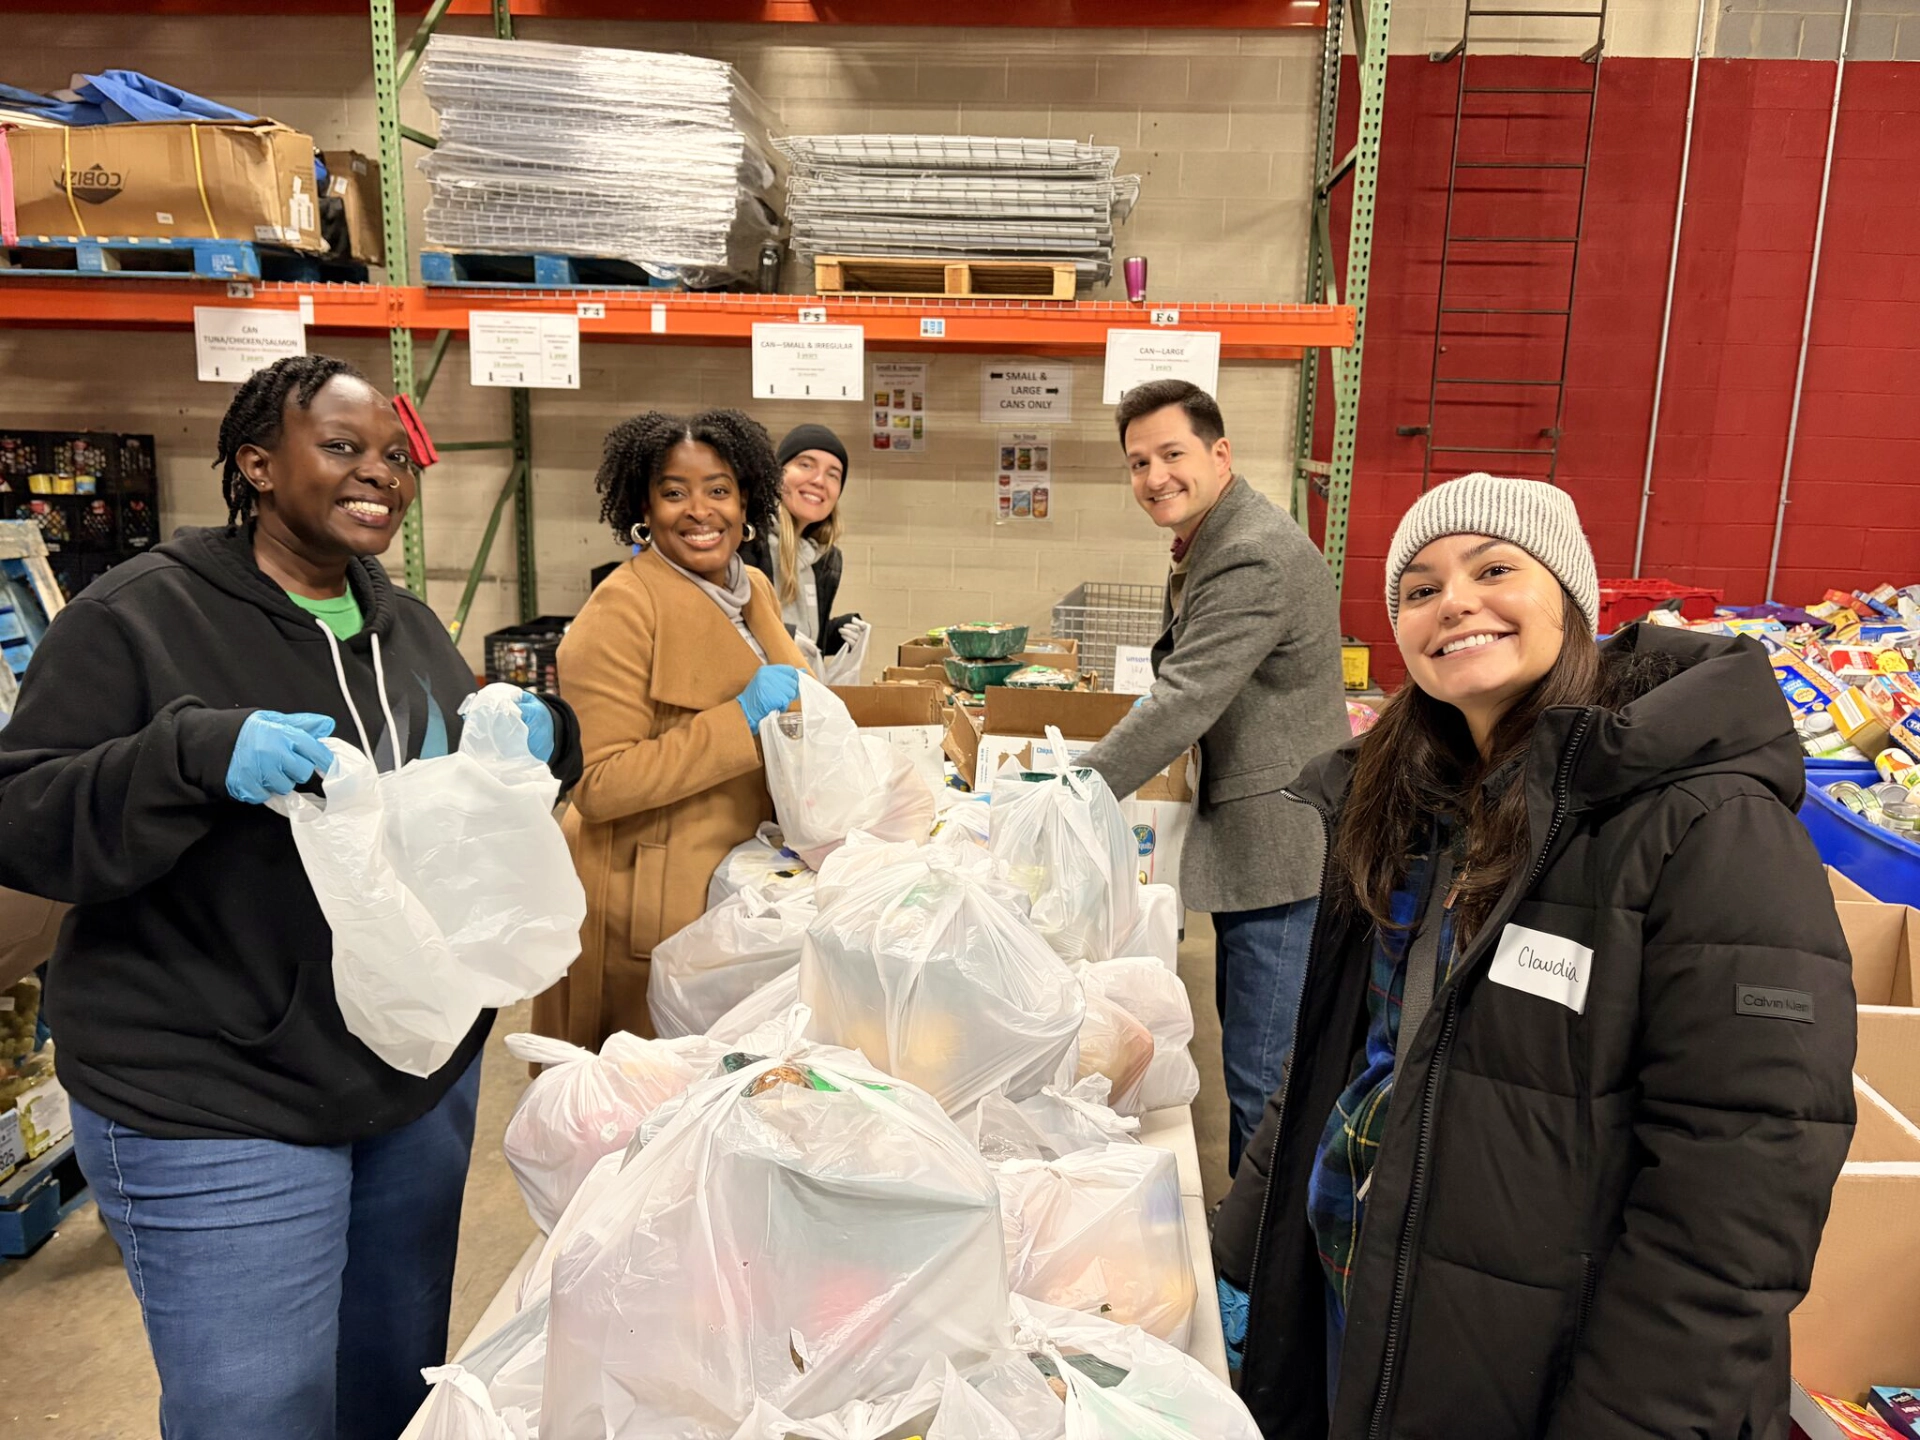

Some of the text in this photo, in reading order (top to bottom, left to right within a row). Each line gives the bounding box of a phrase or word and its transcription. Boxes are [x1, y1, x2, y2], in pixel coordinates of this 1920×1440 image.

[582, 306, 600, 316] F 4
[803, 311, 820, 321] F 5
[1156, 313, 1174, 322] F 6
[242, 326, 258, 334] CAN
[203, 336, 298, 347] TUNA/CHICKEN/SALMON
[814, 342, 854, 350] IRREGULAR
[1005, 372, 1047, 381] SMALL &
[1011, 386, 1042, 395] LARGE
[1000, 400, 1052, 409] CANS ONLY
[1518, 945, 1579, 983] Claudia
[1743, 994, 1810, 1012] Calvin Klein
